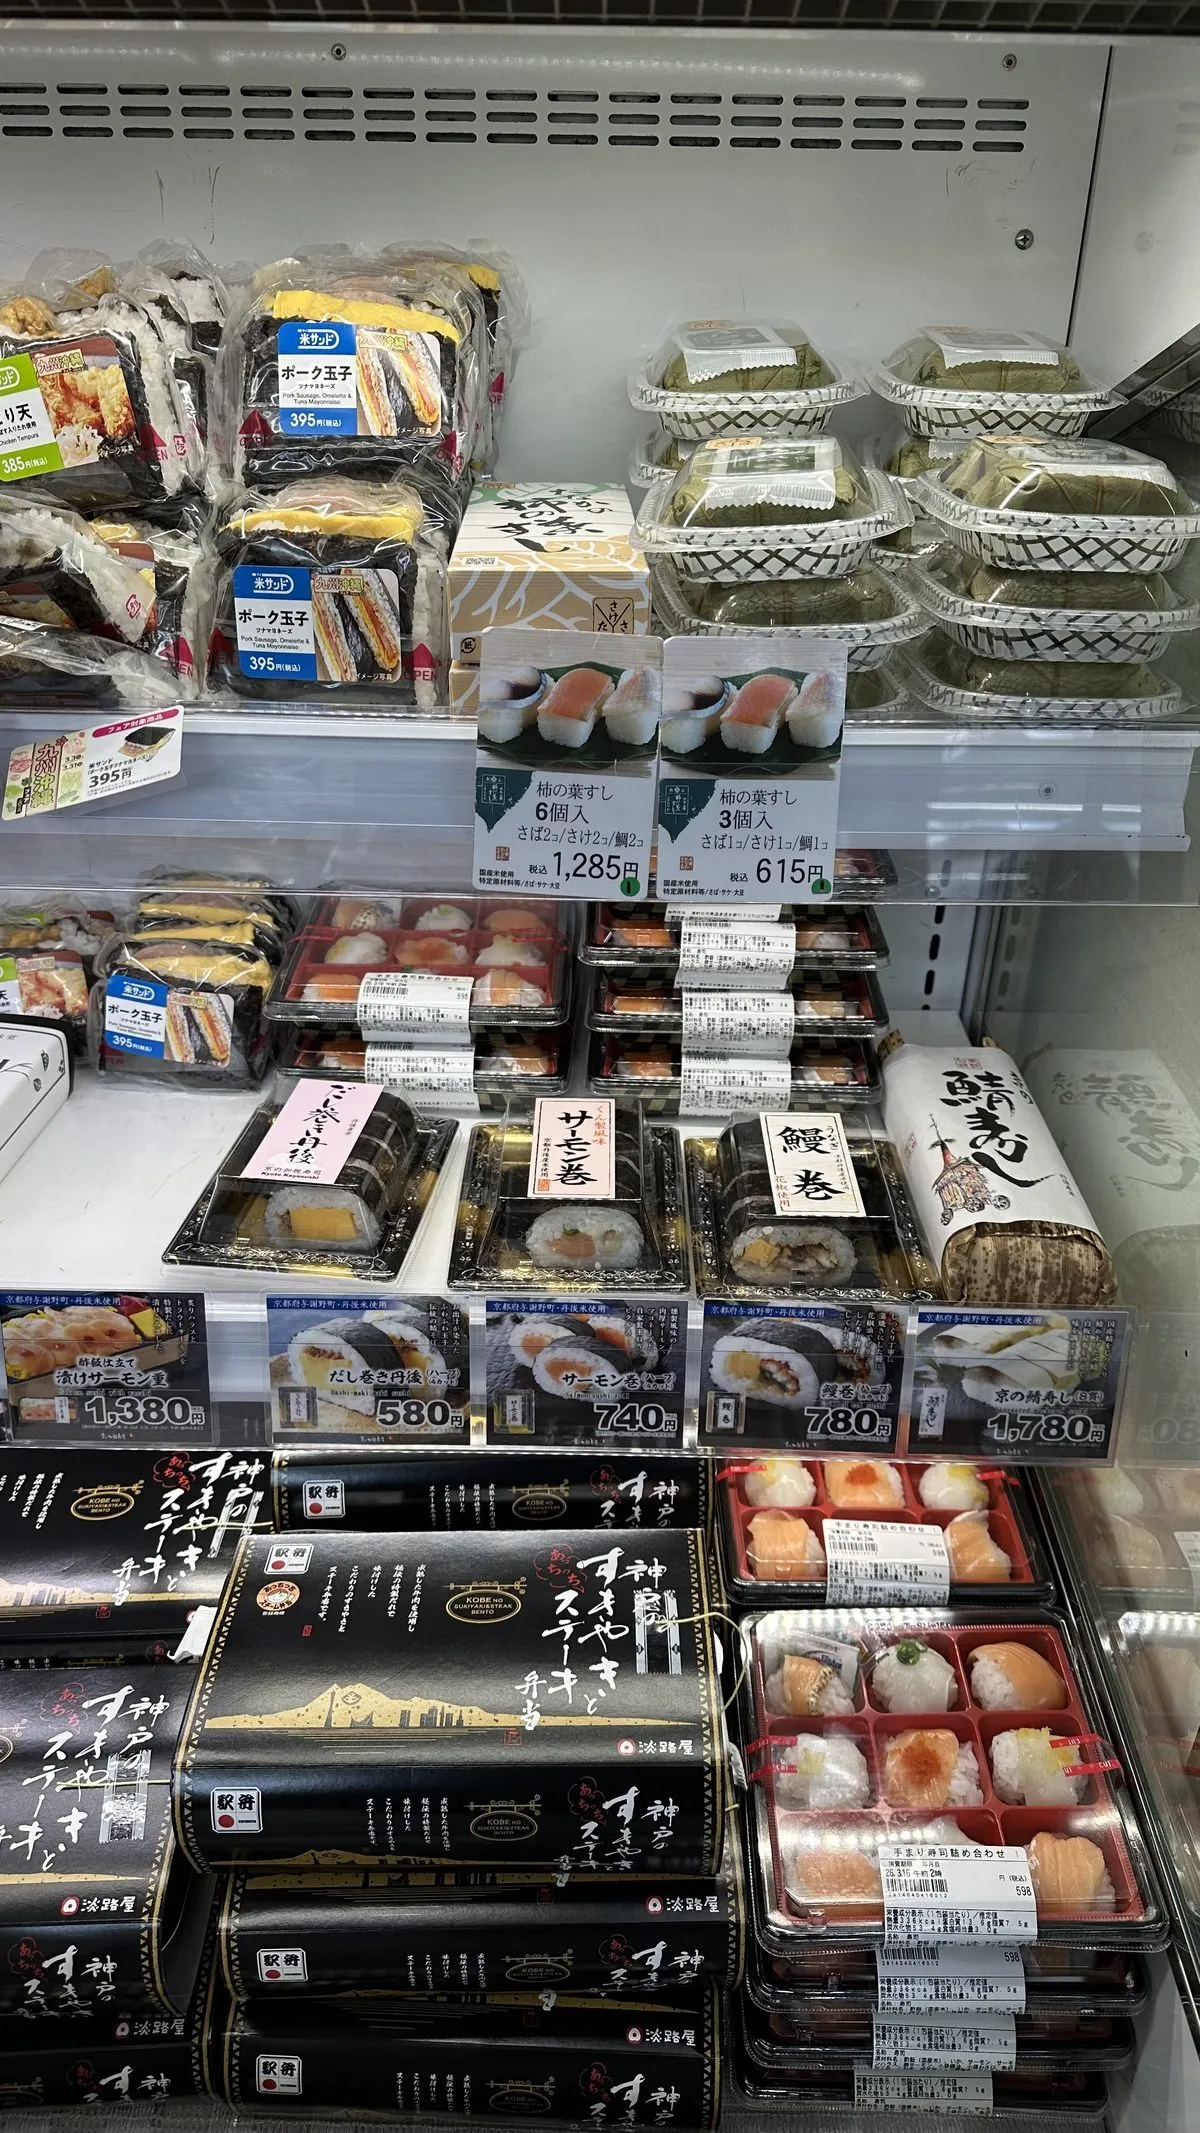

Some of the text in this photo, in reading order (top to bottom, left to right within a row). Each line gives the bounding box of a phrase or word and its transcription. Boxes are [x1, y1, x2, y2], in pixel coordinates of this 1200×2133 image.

[281, 364, 352, 381] ポーク玉子
[0, 403, 33, 425] り天
[315, 576, 363, 592] 九州沖縄
[238, 609, 309, 627] ポーク玉子
[30, 743, 61, 808] 九州沖縄
[536, 781, 615, 801] 柿の葉すし
[719, 788, 798, 806] 柿の葉すし
[535, 802, 590, 824] 6個入
[718, 810, 774, 830] 3個入
[479, 868, 515, 878] 国産米使用
[529, 851, 639, 882] 税込 1,285円
[730, 857, 824, 884] 税込 615円
[663, 879, 699, 887] 国産米使用
[108, 1004, 164, 1024] ポーク玉子
[552, 1110, 598, 1186] サーモン巻
[776, 1125, 847, 1201] 鰻巻
[56, 1371, 168, 1387] 漬けサーモン重
[329, 1369, 422, 1385] だし巻き丹後
[562, 1373, 639, 1389] サーモン巻
[821, 1383, 854, 1399] 鰻巻
[995, 1389, 1072, 1406] 京の鯖寿し
[84, 1396, 206, 1426] 1,380円
[377, 1398, 464, 1428] 580円
[594, 1402, 678, 1432] 740円
[804, 1406, 891, 1437] 780円
[987, 1412, 1105, 1442] 1,780円
[139, 1488, 186, 1584] ステーキ
[112, 1557, 141, 1607] 弁当
[466, 1596, 492, 1604] KOBE
[576, 1546, 630, 1715] すきやきと
[541, 1589, 586, 1704] ステーキ
[515, 1670, 548, 1731] 弁当
[639, 1739, 695, 1756] 淡路屋
[10, 1730, 74, 1861] ステーキ
[486, 1818, 510, 1826] KOBE
[641, 1797, 680, 1850] 神戸の
[893, 1847, 1006, 1859] 手まり寿司詰め合わせ
[1016, 1885, 1032, 1897] 598
[80, 1896, 136, 1913] 淡路屋
[666, 1896, 720, 1913] 淡路屋
[1004, 1951, 1021, 1963] 598
[134, 2018, 185, 2036] 淡路屋
[646, 2028, 696, 2047] 淡路屋
